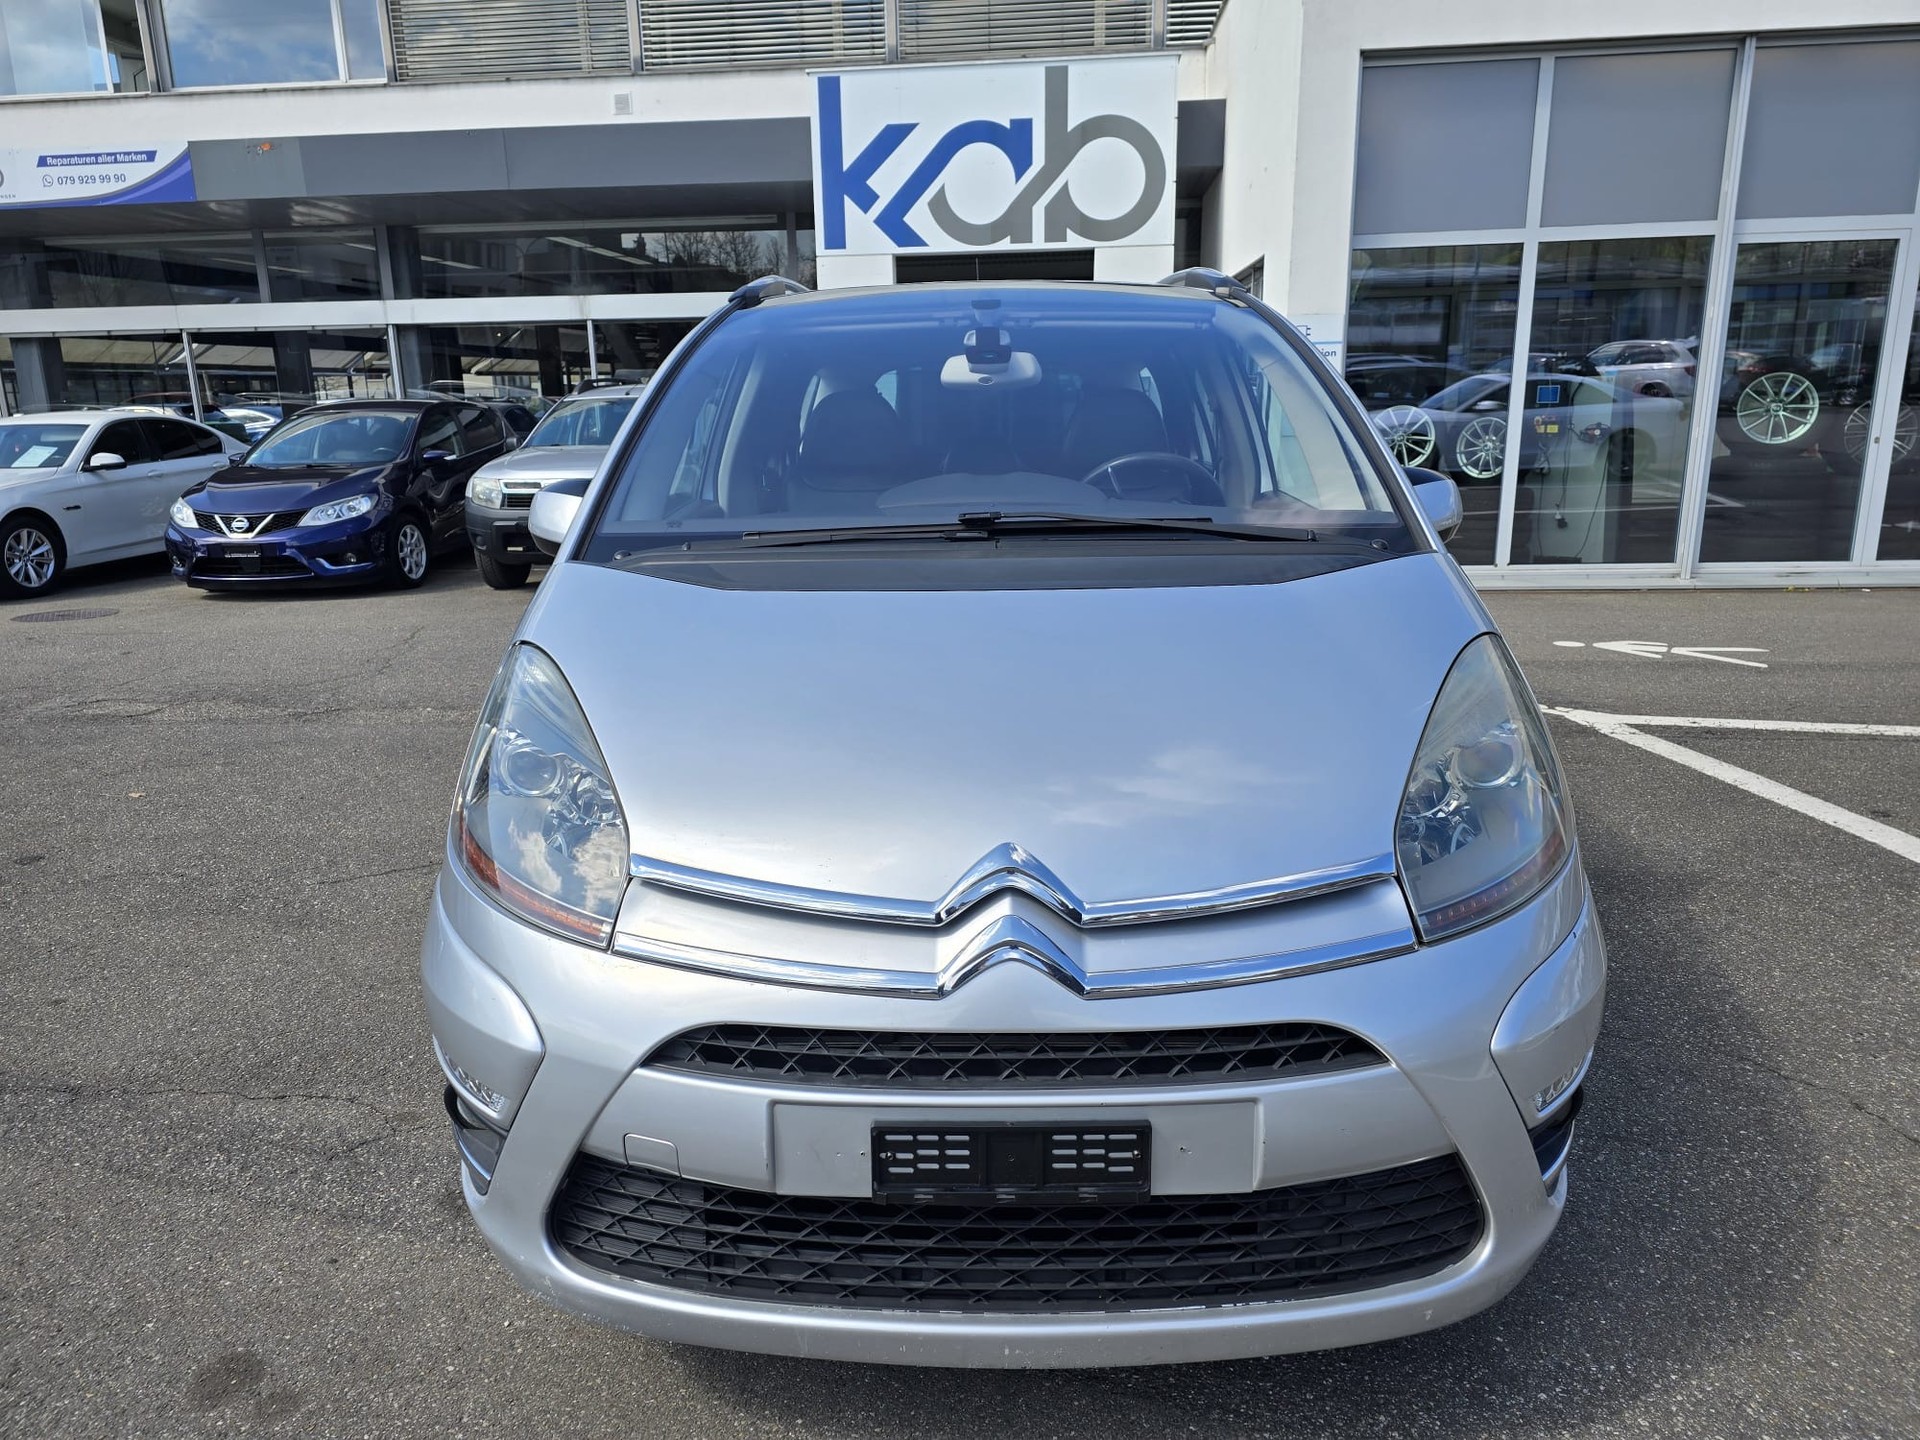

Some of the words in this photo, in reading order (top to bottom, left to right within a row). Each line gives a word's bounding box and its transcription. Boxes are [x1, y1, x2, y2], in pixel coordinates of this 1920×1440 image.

[46, 156, 96, 166] Reparaturen
[97, 154, 115, 163] aller
[117, 153, 147, 162] Marken
[57, 175, 76, 185] 079
[78, 174, 96, 184] 929
[99, 173, 112, 183] 99
[113, 172, 126, 183] 90
